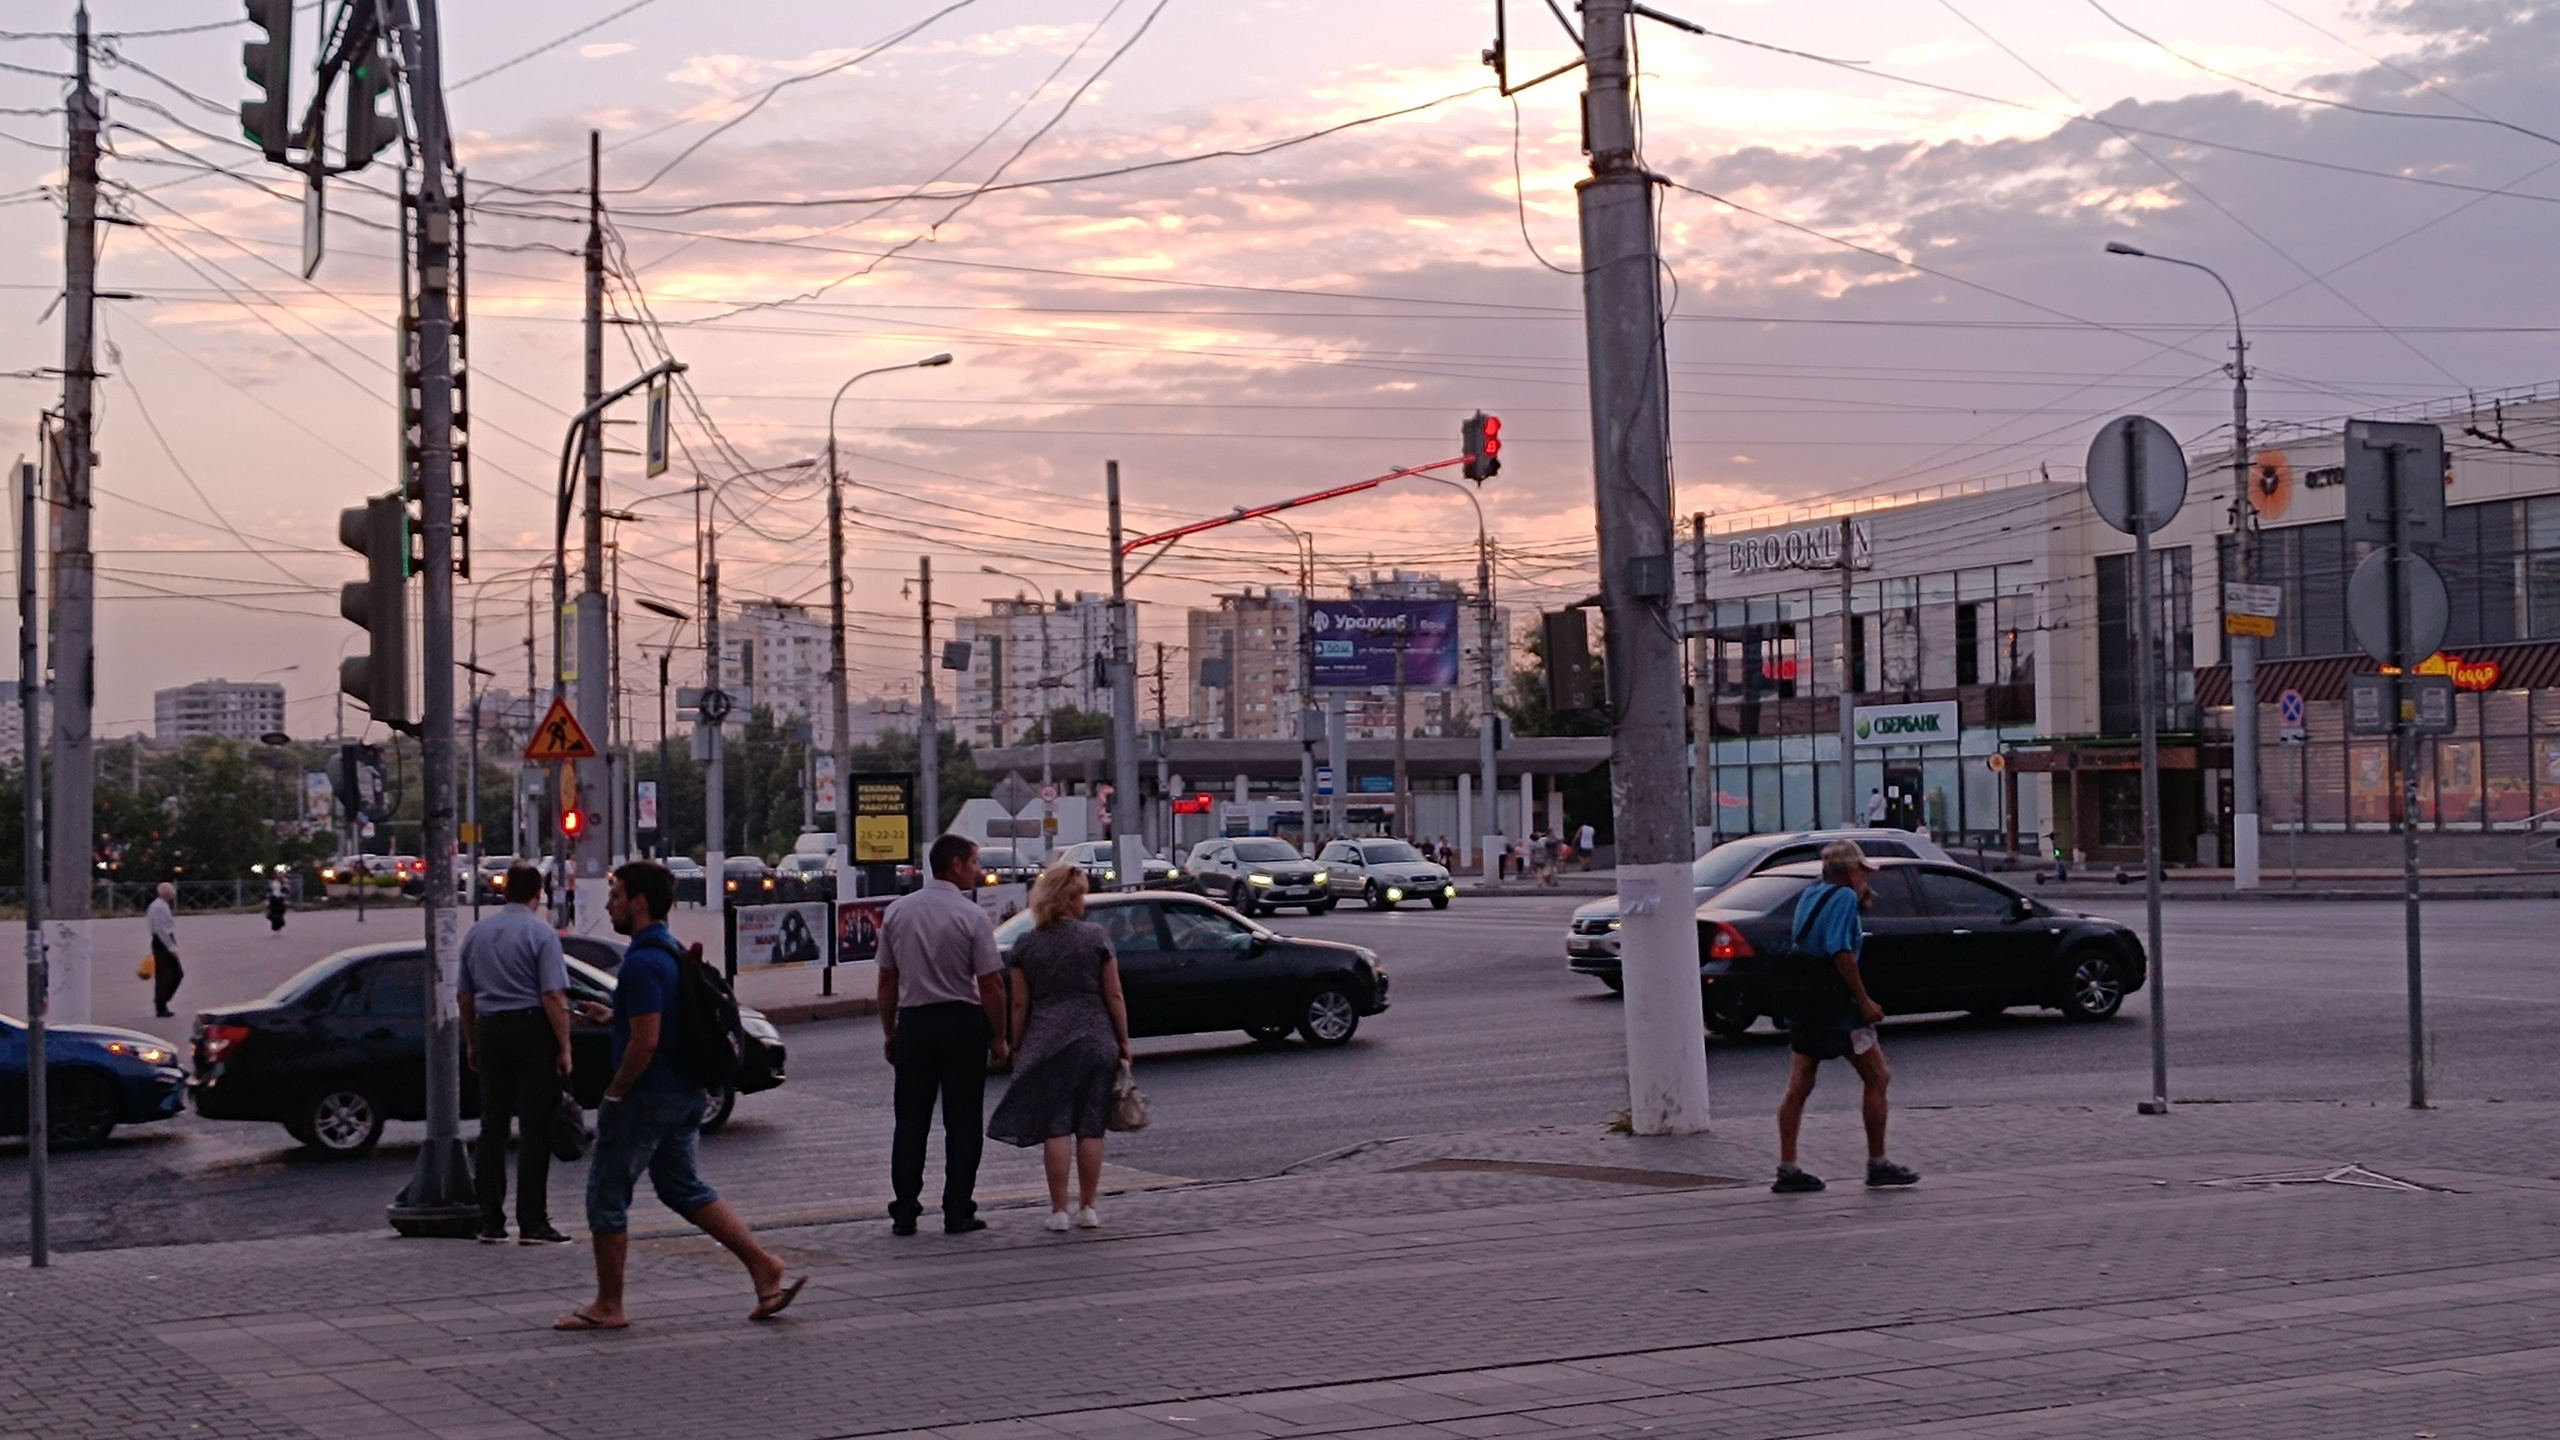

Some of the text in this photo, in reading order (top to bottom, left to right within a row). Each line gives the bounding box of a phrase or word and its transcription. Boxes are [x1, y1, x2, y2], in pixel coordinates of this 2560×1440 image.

[1874, 712, 1942, 735] СБЕРБАНК
[858, 803, 905, 811] РАБОТАЕТ
[860, 829, 906, 840] 25-22-22
